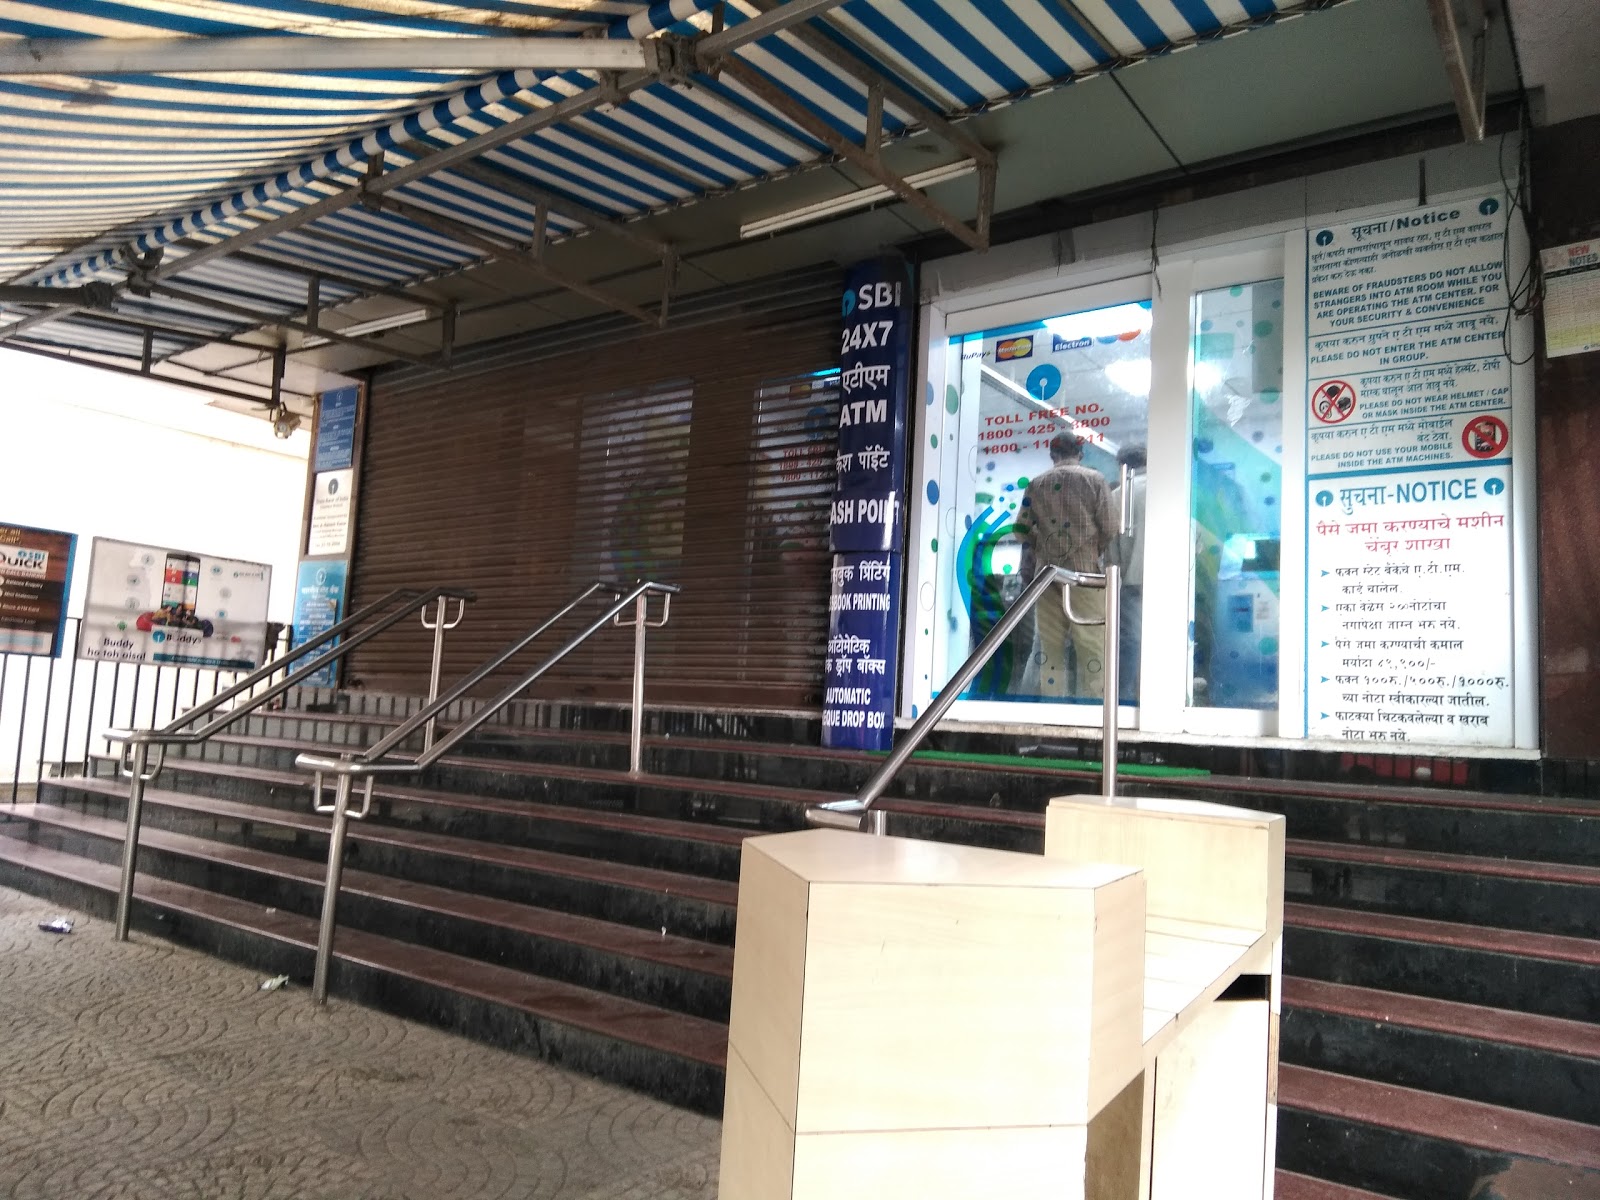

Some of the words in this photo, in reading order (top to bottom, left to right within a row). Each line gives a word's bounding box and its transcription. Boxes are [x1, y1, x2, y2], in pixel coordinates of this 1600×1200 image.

[1568, 244, 1590, 257] NEW
[1568, 253, 1598, 266] NOTES
[1313, 286, 1350, 299] BEWARE
[1352, 284, 1363, 293] OF
[1366, 273, 1426, 290] FRAUDSTERS
[1429, 270, 1442, 279] DO
[1445, 267, 1465, 277] NOT
[1469, 261, 1503, 273] ALLOW
[858, 281, 901, 311] SBI
[1314, 294, 1367, 309] STRANGERS
[1369, 289, 1391, 299] INTO
[1394, 286, 1414, 296] ATM
[1416, 281, 1445, 292] ROOM
[1447, 276, 1478, 287] WHILE
[1481, 272, 1502, 282] YOU
[1316, 309, 1334, 319] ARE
[1336, 301, 1388, 316] OPERATING
[1391, 297, 1410, 307] THE
[1412, 294, 1432, 304] ATM
[1435, 288, 1477, 300] CENTER.
[1479, 284, 1500, 293] FOR
[1330, 317, 1355, 327] YOUR
[1357, 309, 1402, 323] SECURITY
[1415, 297, 1485, 314] CONVENIENCE
[841, 321, 894, 355] 24X7
[1054, 339, 1090, 351] Electron
[1310, 353, 1344, 364] PLEASE
[1347, 350, 1360, 359] DO
[1362, 347, 1382, 357] NOT
[1384, 342, 1415, 354] ENTER
[1418, 340, 1438, 349] THE
[1440, 336, 1461, 346] ATM
[1464, 330, 1505, 343] CENTER
[1379, 357, 1390, 366] IN
[1392, 352, 1429, 364] GROUP.
[842, 361, 890, 394] एटीएम
[1360, 400, 1391, 410] PLEASE
[1405, 397, 1421, 405] NOT
[1424, 394, 1448, 403] WEAR
[1450, 390, 1484, 400] HELMET
[1491, 387, 1509, 395] CAP
[1375, 409, 1398, 417] MASK
[1400, 406, 1427, 414] INSIDE
[1430, 404, 1447, 412] THE
[1448, 402, 1467, 410] ATM
[1469, 398, 1506, 407] CENTER.
[839, 399, 887, 428] ATM
[984, 413, 1024, 426] TOLL
[1028, 406, 1070, 421] FREE
[1075, 403, 1104, 415] NO.
[978, 428, 1013, 441] 1800
[1027, 423, 1056, 435] 425
[1071, 416, 1110, 430] 3800
[984, 442, 1018, 455] 1800
[1311, 452, 1341, 461] PLEASE
[1356, 449, 1373, 457] NOT
[1394, 445, 1418, 454] YOUR
[1420, 443, 1453, 451] MOBILE
[1385, 456, 1403, 464] ATM
[1406, 452, 1453, 462] MACHINES.
[830, 499, 854, 526] ASH
[1316, 519, 1341, 536] पैसे
[1345, 522, 1378, 534] जमा
[1383, 513, 1451, 533] करण्याचे
[1456, 511, 1505, 528] मशीन
[1405, 537, 1451, 550] शाखा
[853, 593, 890, 611] PRINTING
[87, 647, 100, 656] ho
[103, 648, 120, 658] toh
[103, 638, 134, 649] Buddy
[1430, 640, 1464, 650] कमाल
[857, 654, 886, 675] बॉक्स
[826, 687, 871, 705] AUTOMATIC
[1362, 691, 1384, 703] नोटा
[1448, 692, 1489, 707] जातील.
[841, 709, 865, 727] DROP
[867, 711, 885, 729] BOX
[1447, 715, 1455, 725] व
[1459, 715, 1489, 728] खराब
